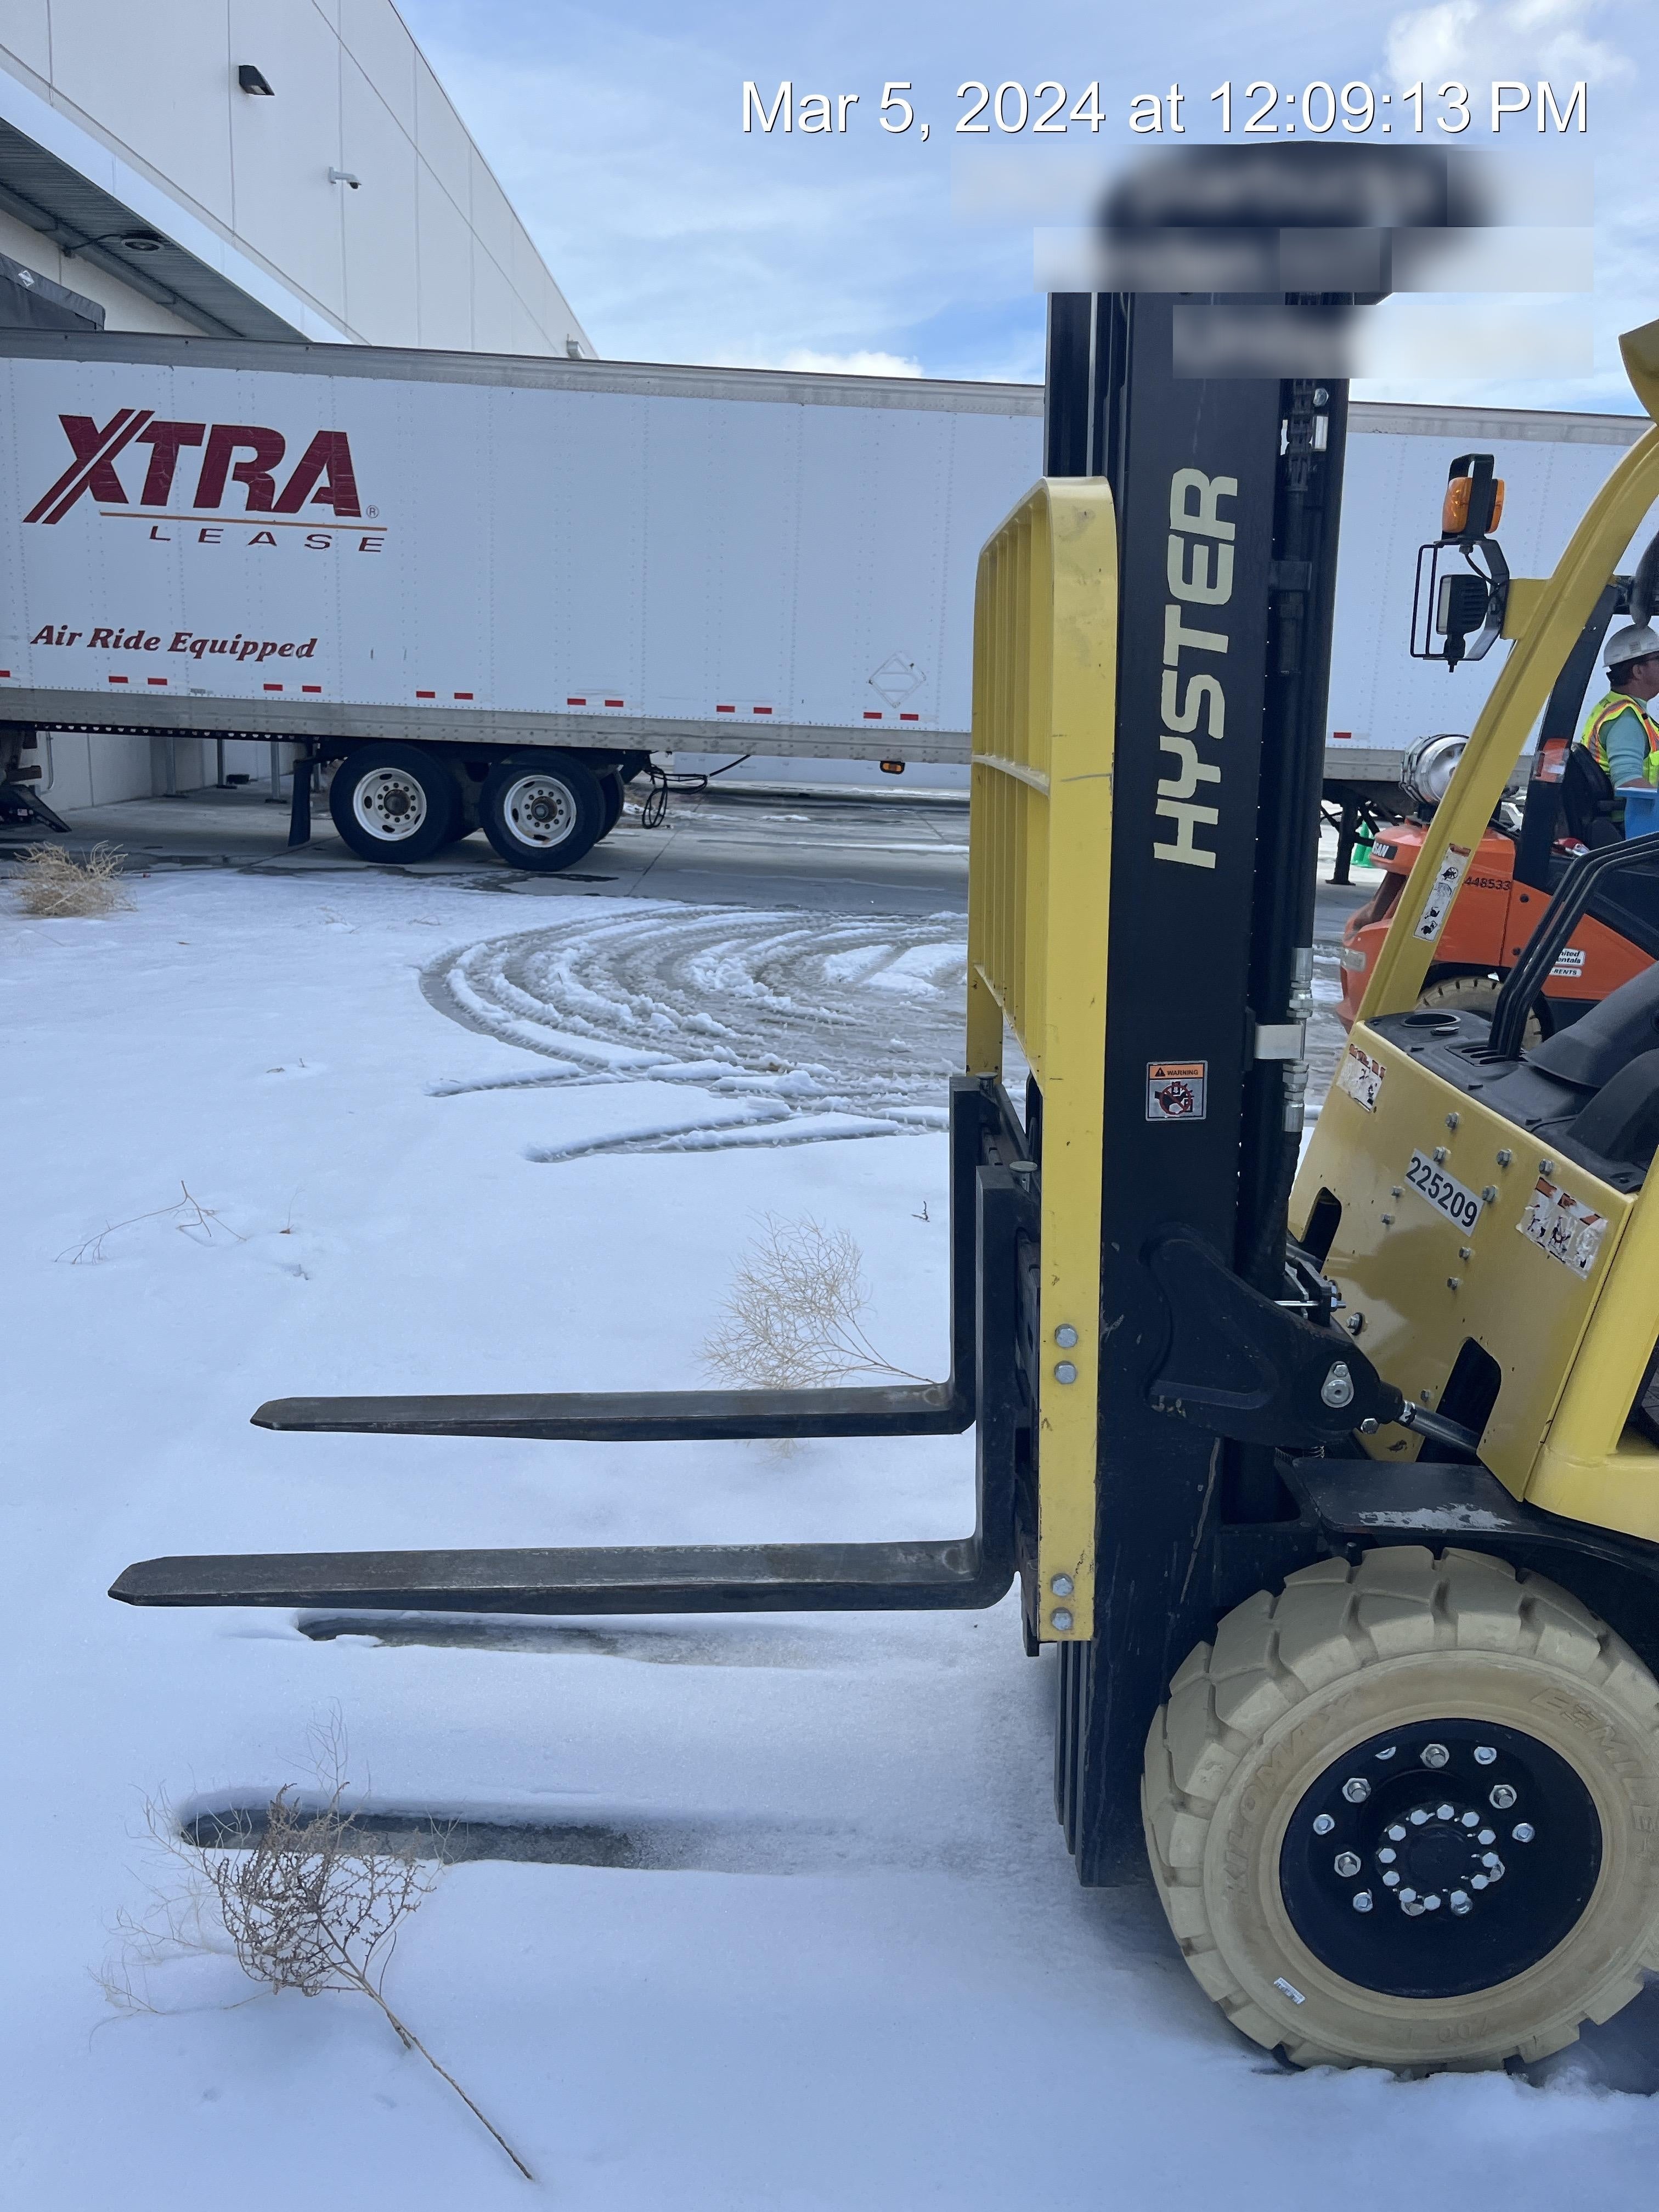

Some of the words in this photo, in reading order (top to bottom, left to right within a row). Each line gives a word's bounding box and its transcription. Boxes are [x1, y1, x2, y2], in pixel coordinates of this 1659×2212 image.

[22, 408, 362, 525] XTRA
[149, 526, 385, 553] LEASE
[30, 624, 83, 647] Air
[86, 627, 161, 652] Ride
[167, 632, 319, 663] Equipped
[1153, 468, 1238, 869] HYSTER
[1406, 1156, 1477, 1227] 225209
